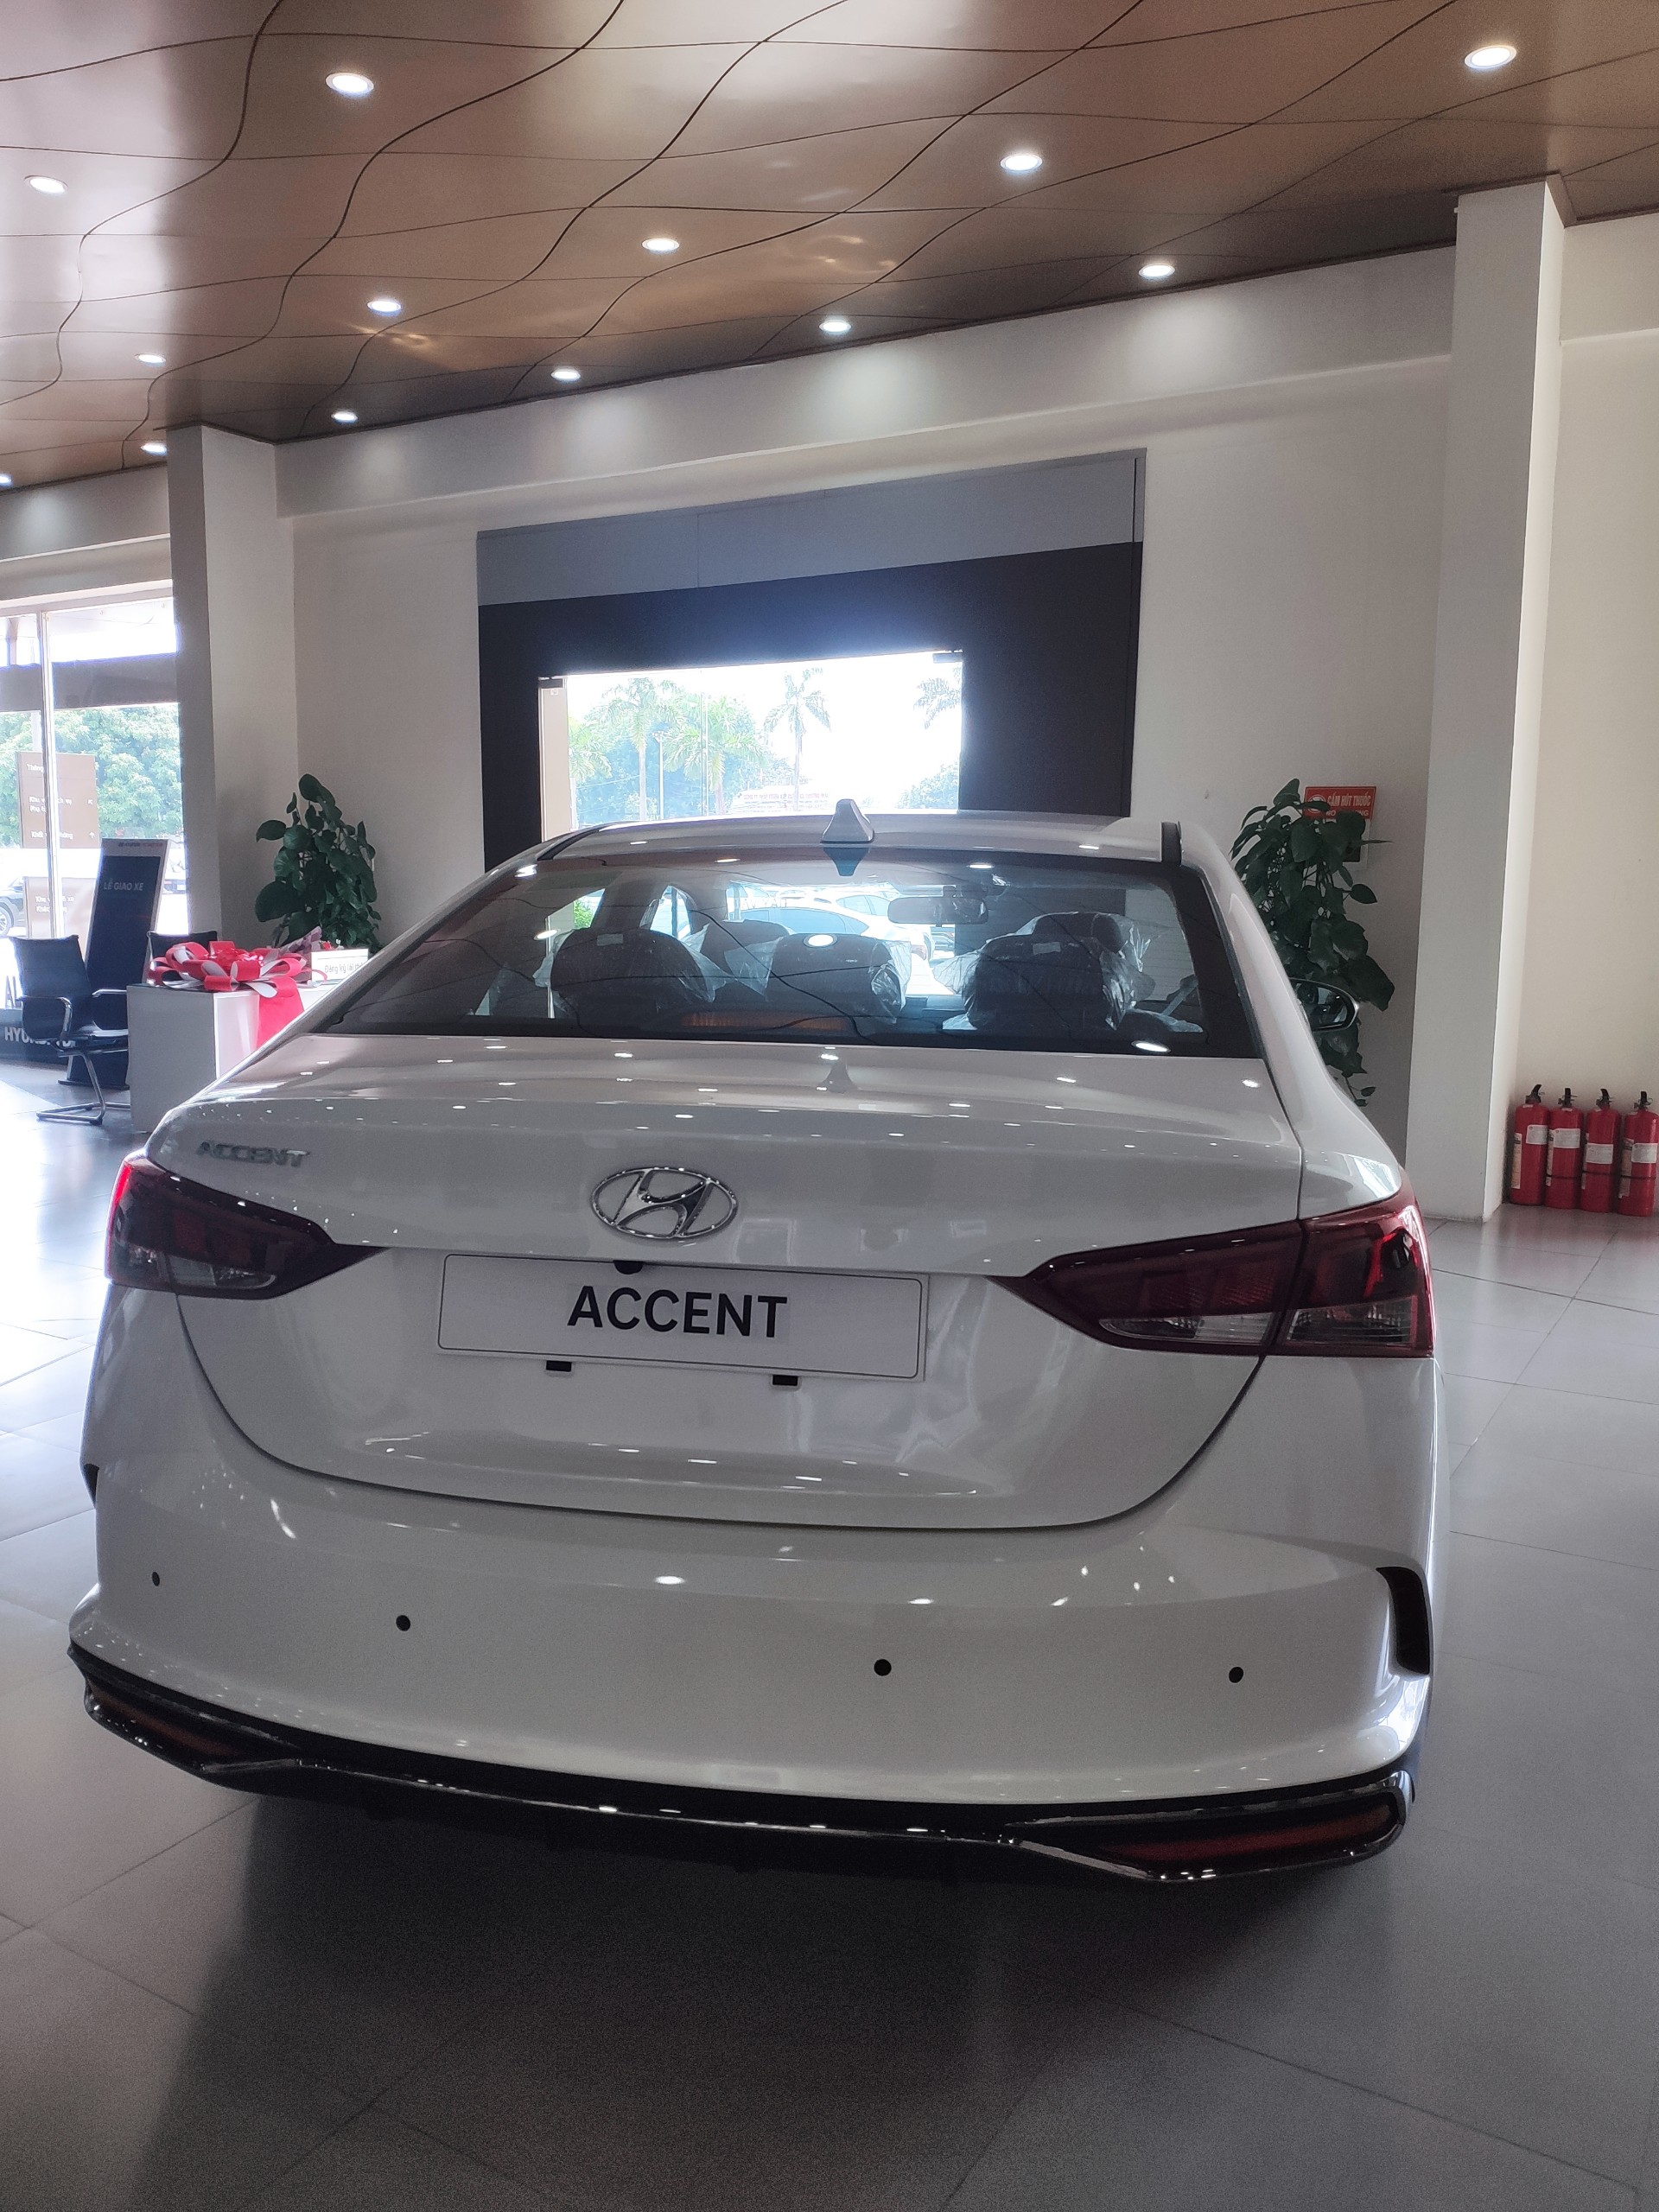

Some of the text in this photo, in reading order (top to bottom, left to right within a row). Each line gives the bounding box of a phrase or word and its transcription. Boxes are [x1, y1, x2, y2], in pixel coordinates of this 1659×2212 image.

[113, 881, 133, 891] GIAO
[133, 882, 144, 891] XE
[196, 1140, 310, 1168] ACCENT
[566, 1285, 789, 1339] ACCENT
